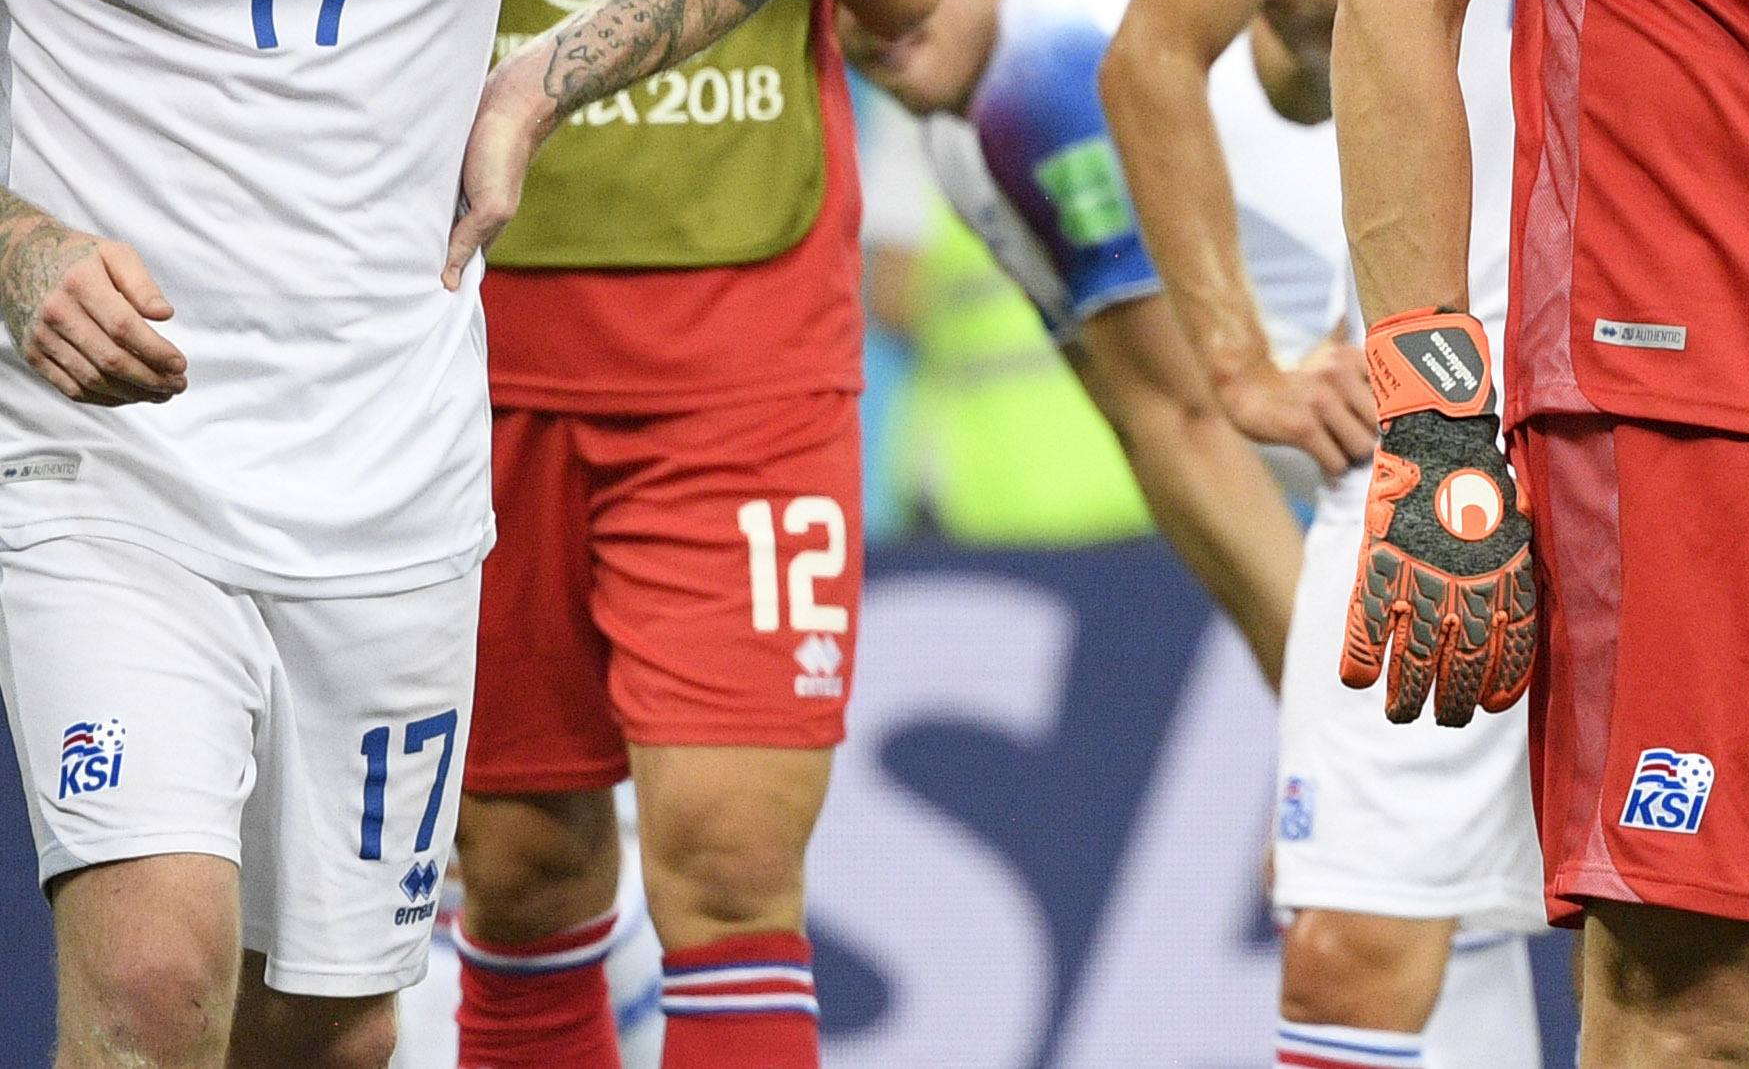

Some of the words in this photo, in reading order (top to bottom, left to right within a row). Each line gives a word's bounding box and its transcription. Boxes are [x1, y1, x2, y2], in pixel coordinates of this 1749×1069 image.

[647, 66, 784, 124] 2018
[1636, 328, 1681, 344] AUTHENTIC
[737, 495, 849, 634] 12
[359, 708, 458, 860] 17
[394, 900, 435, 925] errea
